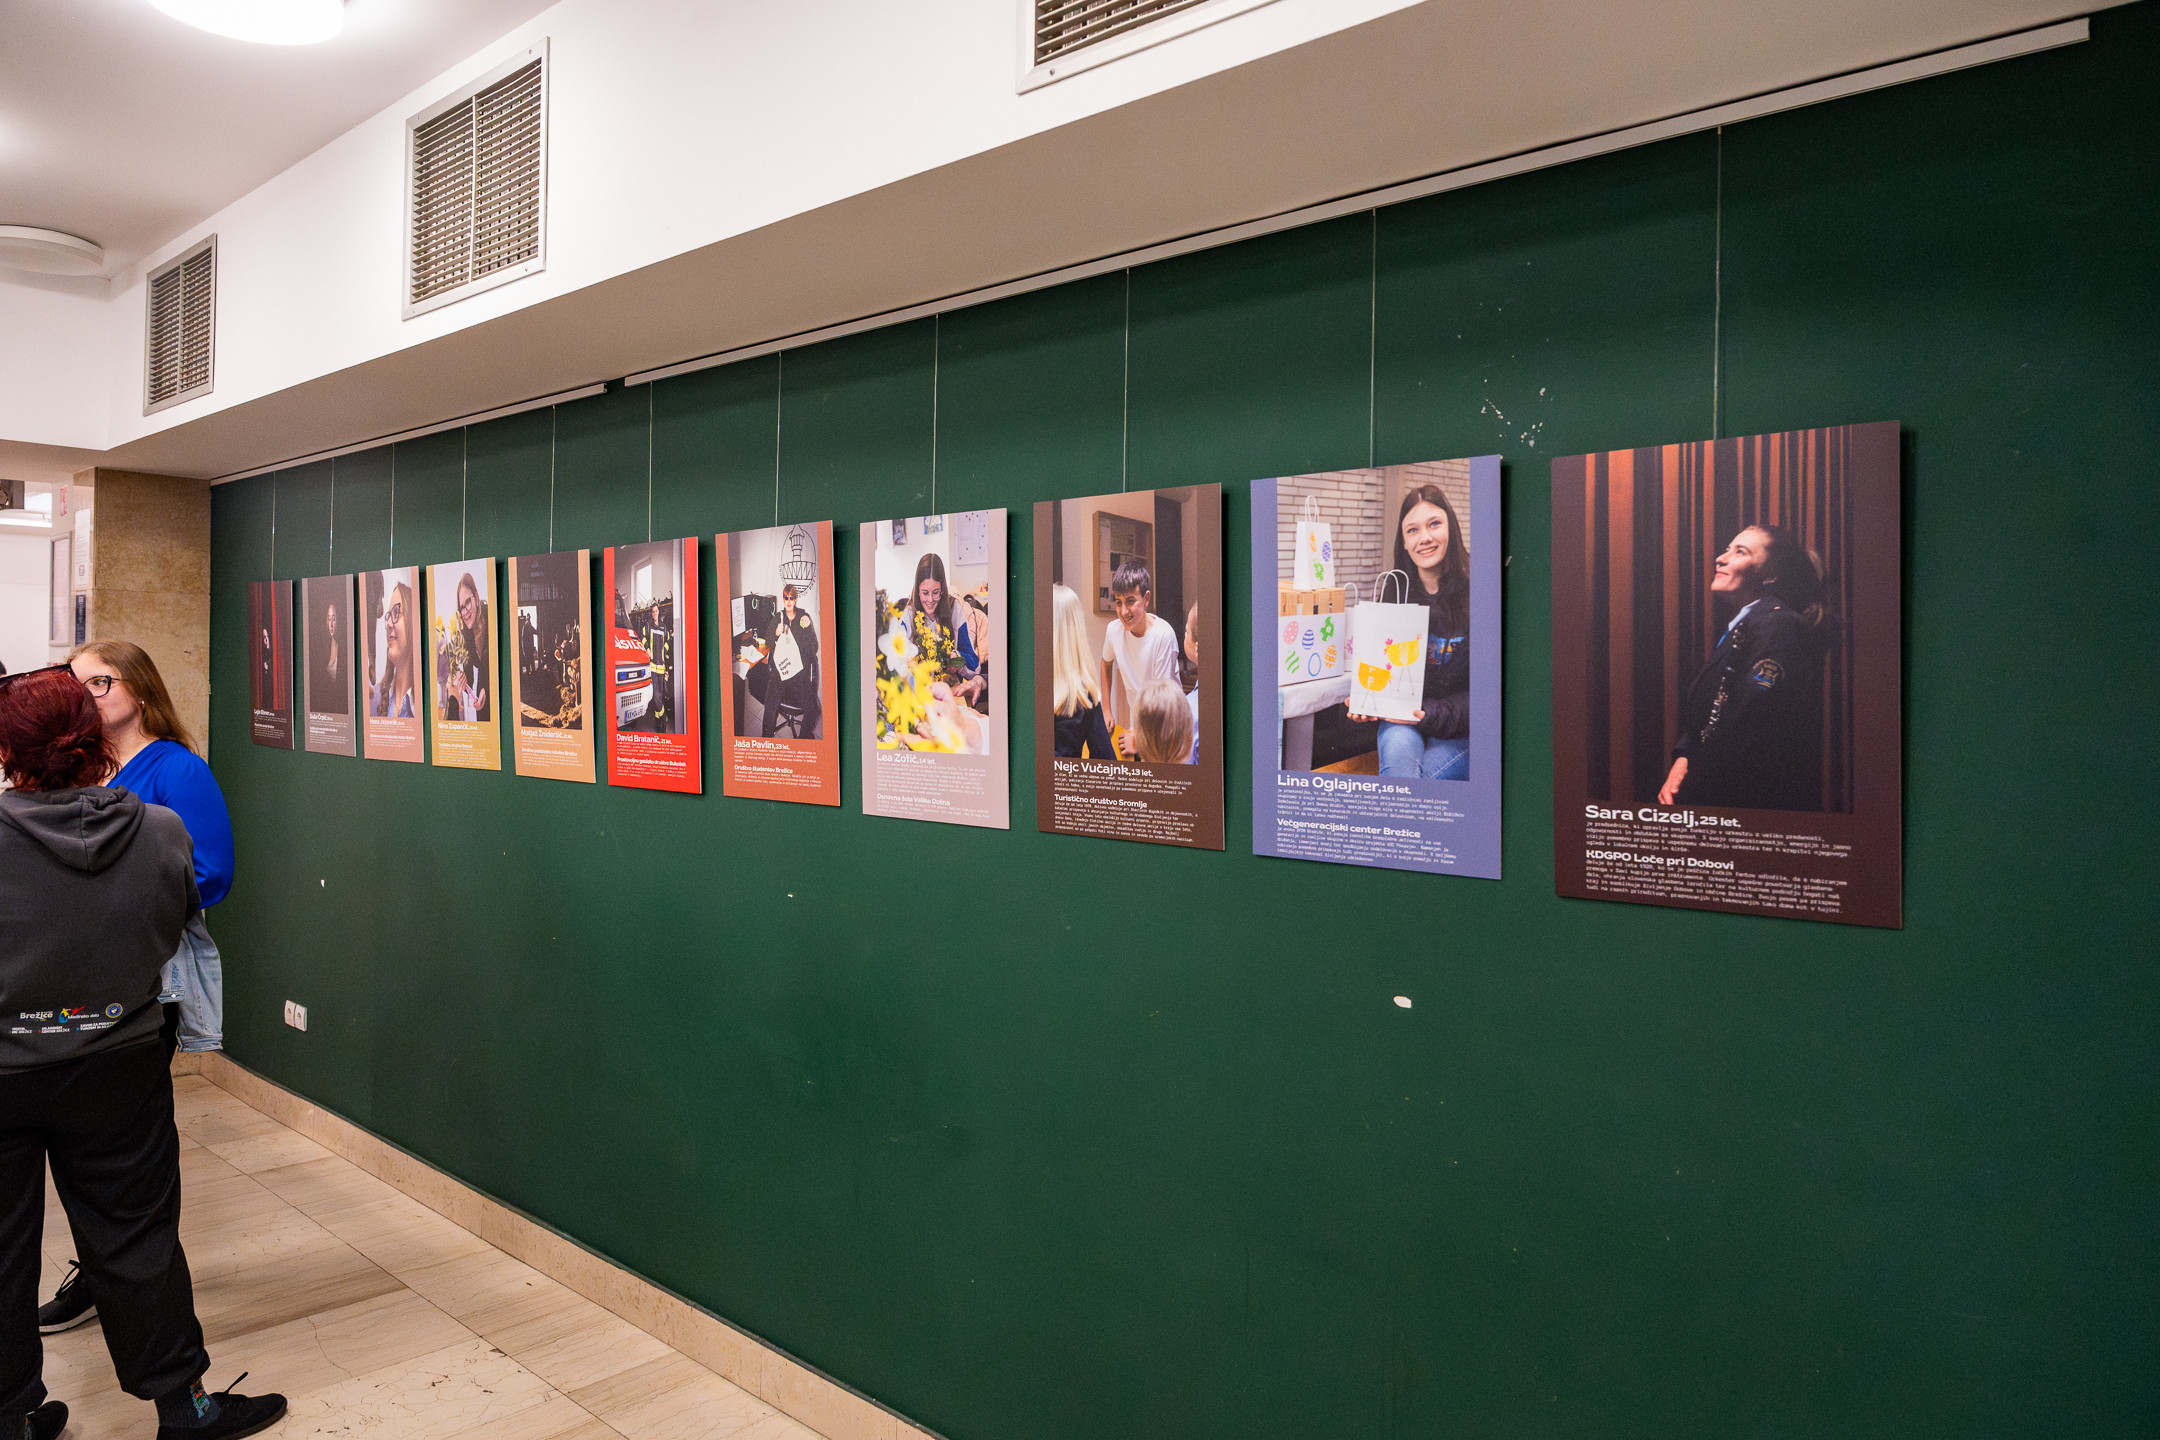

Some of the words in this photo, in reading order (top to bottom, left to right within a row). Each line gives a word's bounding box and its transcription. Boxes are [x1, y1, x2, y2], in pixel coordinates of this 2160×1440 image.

[734, 739, 750, 748] Jaša
[877, 752, 892, 762] Lea
[1054, 761, 1079, 774] Nejc
[1277, 774, 1309, 787] Lina
[1312, 776, 1381, 793] Oglajner,
[1054, 794, 1088, 803] Turistično
[1090, 797, 1117, 805] društvo
[1118, 799, 1148, 809] Sromlje
[1585, 805, 1634, 820] Sara
[1638, 808, 1699, 828] Cizelj,
[1700, 816, 1718, 825] 25
[1277, 818, 1348, 832] Večgeneracijski
[1350, 825, 1381, 834] center
[1383, 827, 1421, 838] Brežice
[1586, 850, 1631, 861] KDGPO
[1633, 854, 1664, 864] Loče
[1666, 857, 1684, 866] pri
[1688, 858, 1734, 870] Dobovi
[20, 1011, 53, 1019] Brežice
